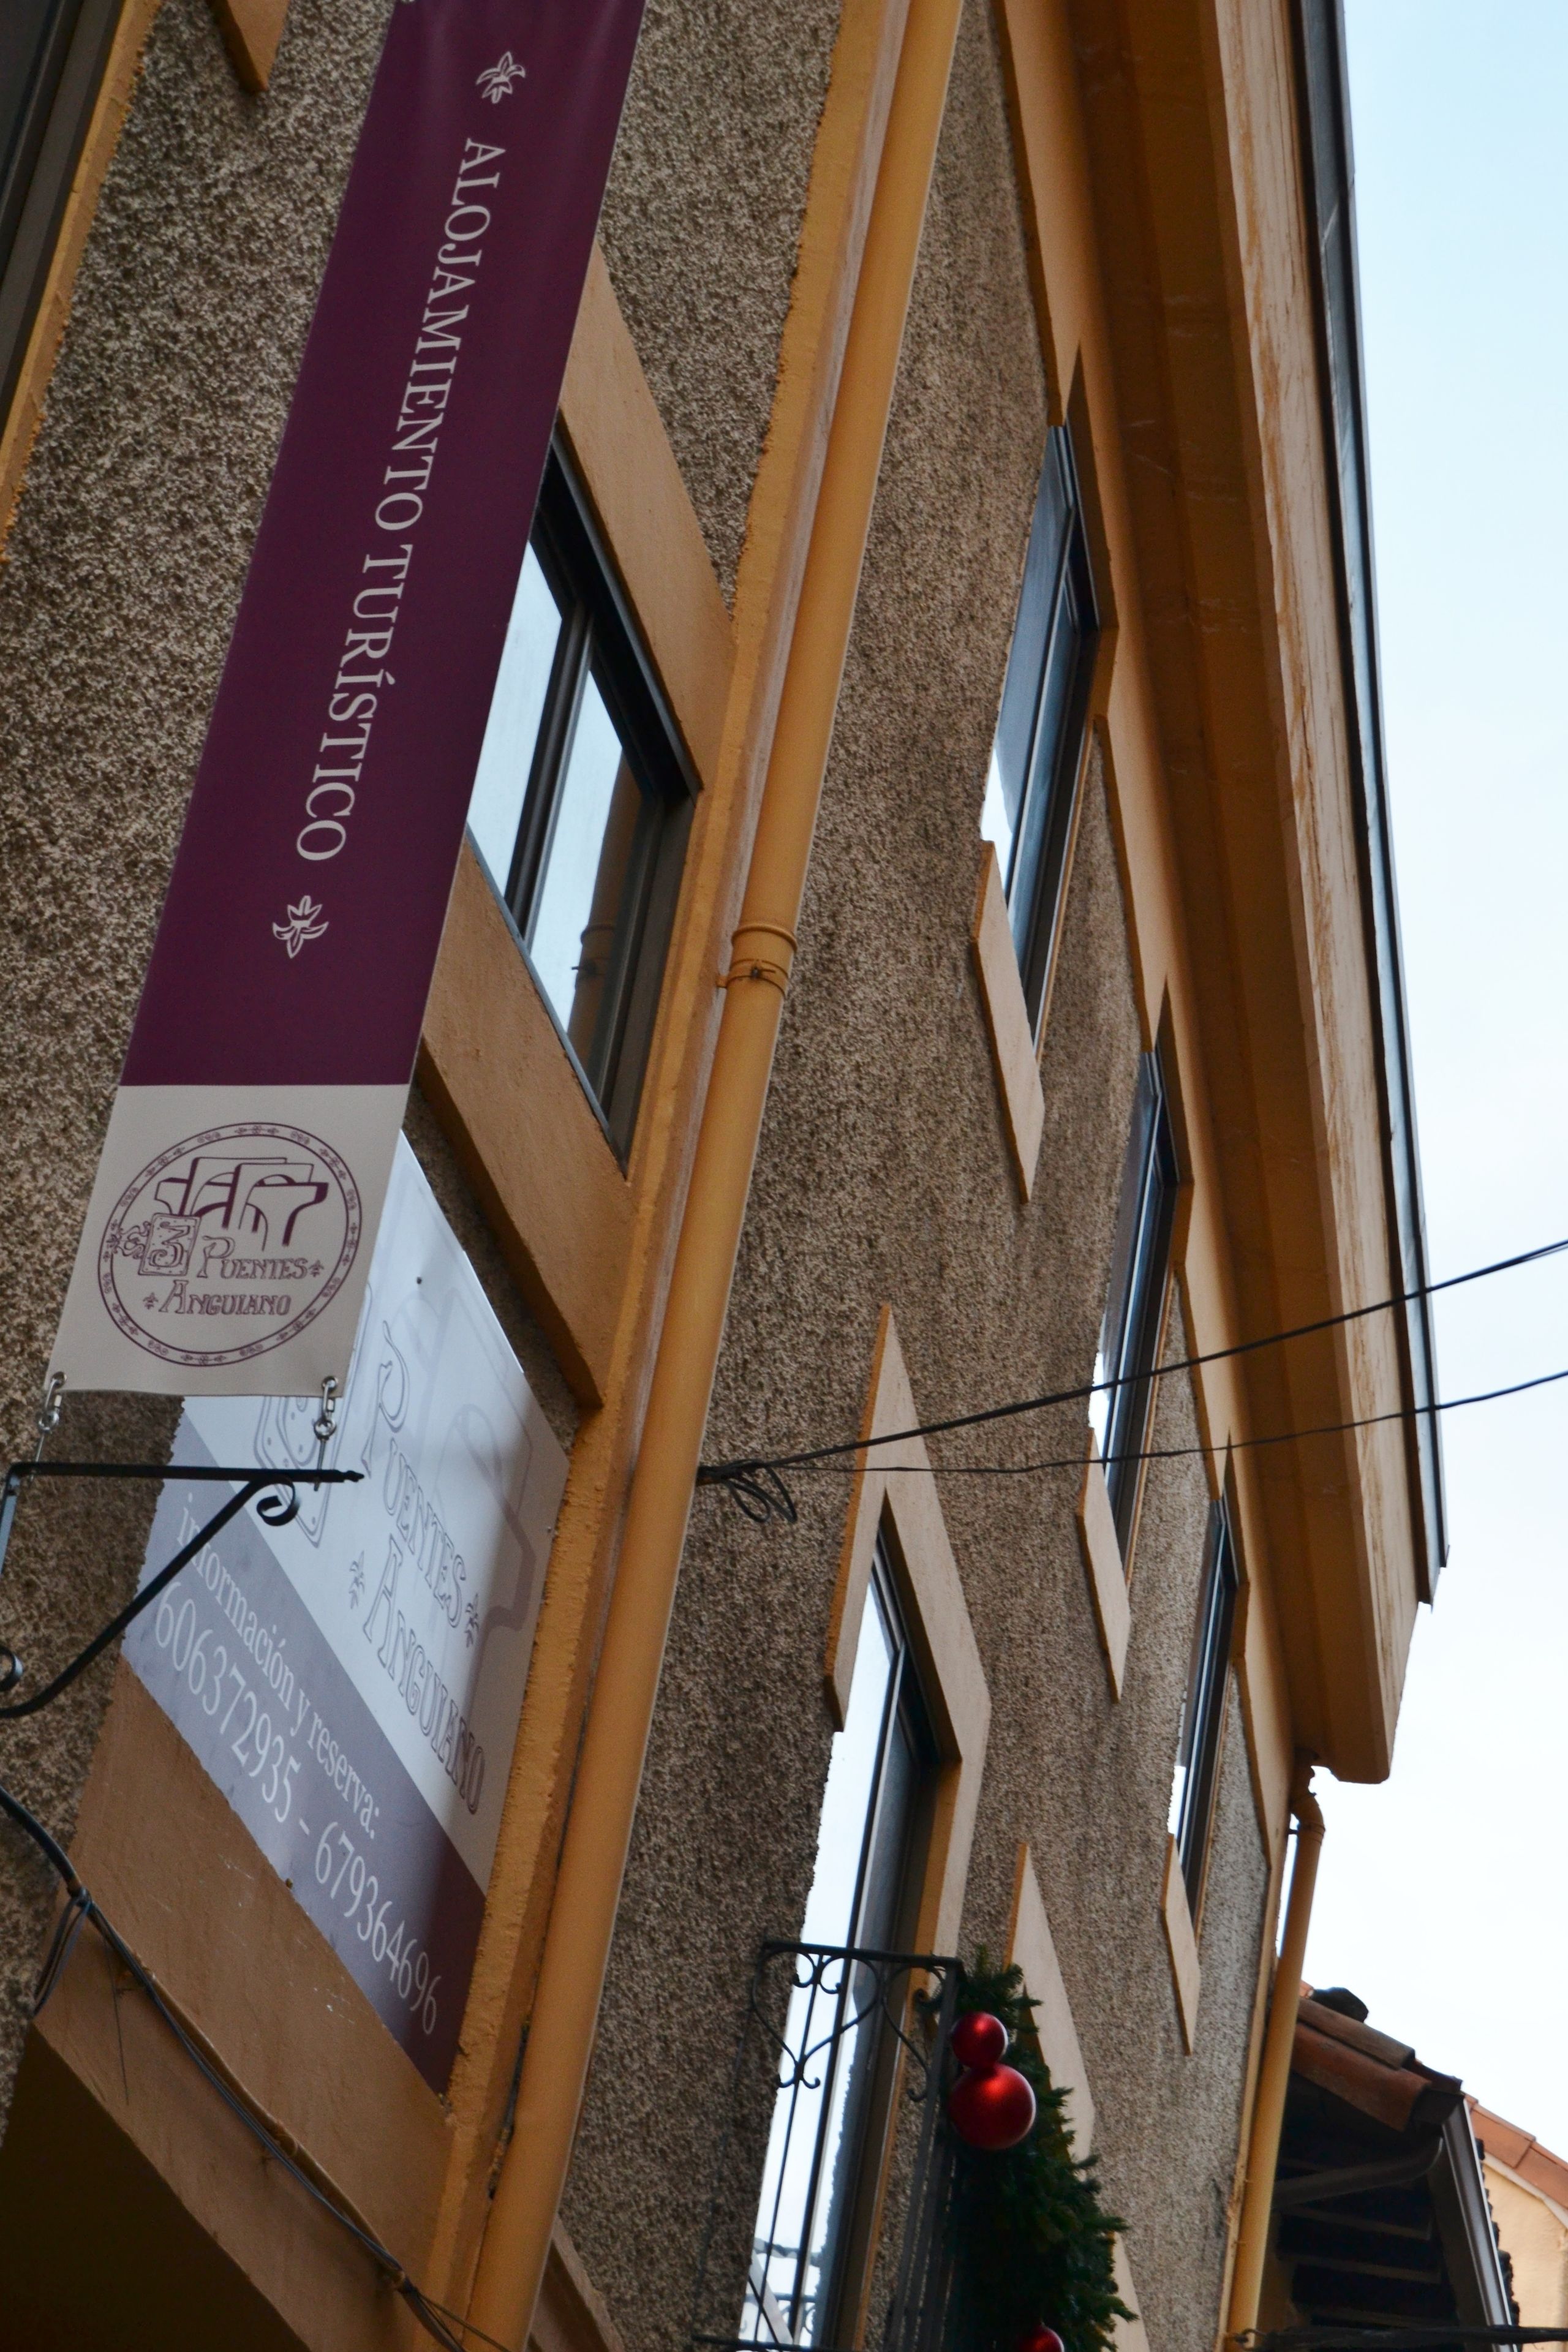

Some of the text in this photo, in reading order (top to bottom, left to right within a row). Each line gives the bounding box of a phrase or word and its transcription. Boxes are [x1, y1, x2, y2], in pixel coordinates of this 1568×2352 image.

[297, 138, 506, 861] ALOJAMIENTO TURÍSTICO
[148, 1221, 309, 1280] 3 PUENTES
[158, 1279, 292, 1316] ANGUIANO
[361, 1319, 467, 1629] PUENTES
[154, 1580, 302, 1823] 606372935
[315, 1821, 442, 2035] 679364696
[289, 1687, 311, 1738] y
[306, 1711, 380, 1840] reserva:
[363, 1532, 486, 1816] ANGUIANO
